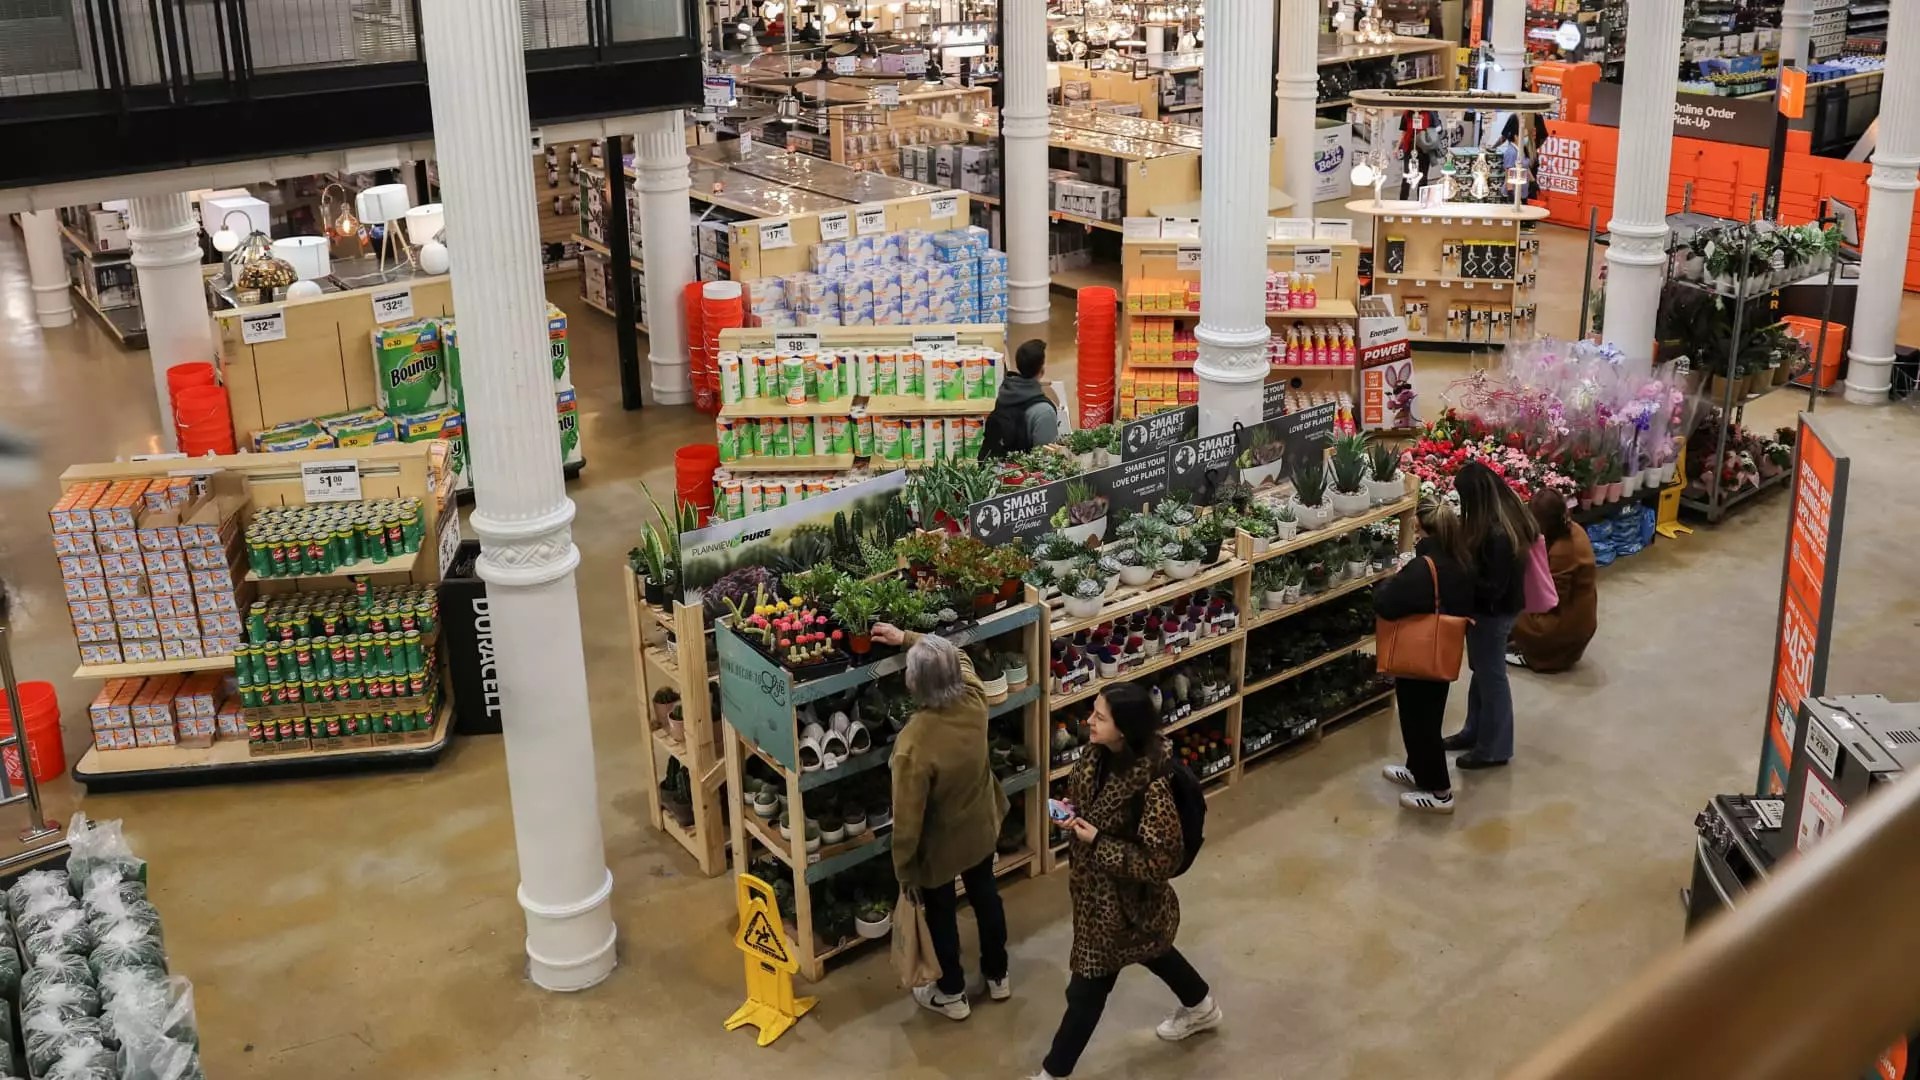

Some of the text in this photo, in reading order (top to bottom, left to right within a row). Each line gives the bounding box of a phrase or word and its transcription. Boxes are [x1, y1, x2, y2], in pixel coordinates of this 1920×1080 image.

[1673, 101, 1737, 120] Online Order
[1369, 325, 1399, 339] Energizer
[1363, 342, 1407, 361] POWER
[390, 354, 437, 388] Bounty
[1149, 411, 1186, 431] SMART
[1197, 433, 1237, 453] SMART
[1124, 456, 1166, 475] SHARE YOUR
[1112, 467, 1166, 489] LOVE OF PLANTS
[1002, 488, 1049, 513] SMART
[691, 528, 772, 557] PLAINVIEW PURE
[472, 597, 501, 718] DURACELL
